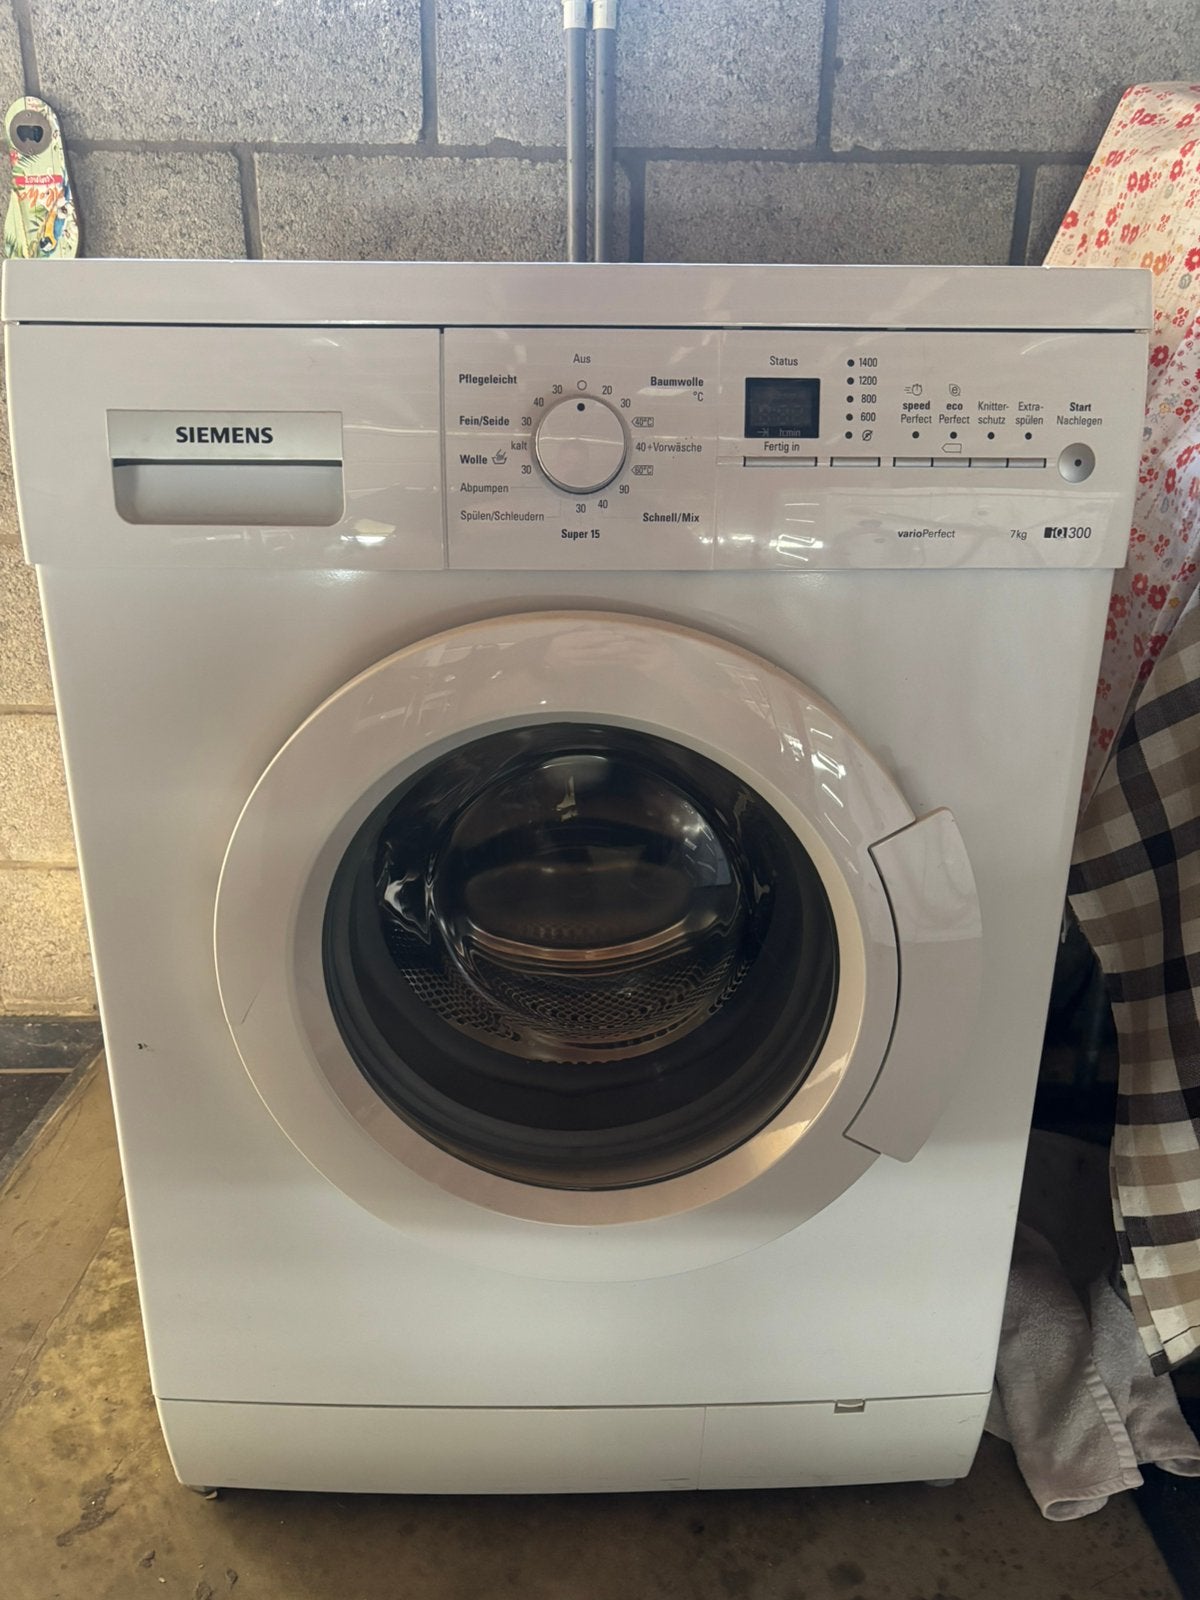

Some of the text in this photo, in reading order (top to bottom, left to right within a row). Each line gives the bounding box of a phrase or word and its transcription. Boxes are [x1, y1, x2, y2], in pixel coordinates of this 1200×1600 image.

[573, 354, 591, 363] Aus
[770, 356, 798, 366] Status
[859, 358, 877, 367] 1400
[459, 374, 517, 386] Pflegeleicht
[651, 376, 703, 386] Baumwolle
[859, 376, 877, 385] 1200
[552, 385, 562, 394] 30
[602, 385, 612, 395] 20
[693, 391, 703, 402] °C
[861, 394, 876, 403] 800
[534, 397, 544, 407] 40
[621, 398, 631, 408] 30
[902, 400, 931, 412] speed
[978, 401, 1009, 411] Knitter-
[1018, 401, 1044, 411] Extra-
[1070, 402, 1091, 411] Start
[460, 416, 509, 426] Fein/Seide
[522, 417, 532, 426] 30
[861, 412, 876, 421] 600
[901, 414, 932, 424] Perfect
[939, 414, 970, 424] Perfect
[978, 415, 1005, 424] schutz
[1016, 415, 1043, 426] spülen
[1057, 416, 1102, 427] Nachlegen
[176, 427, 273, 443] SIEMENS
[511, 441, 528, 450] kalt
[764, 441, 800, 453] Fertig in
[460, 455, 487, 464] Wolle
[522, 466, 531, 474] 30
[460, 483, 508, 494] Abpumpen
[619, 485, 629, 494] 90
[576, 504, 586, 513] 30
[598, 499, 608, 508] 40
[461, 510, 544, 521] Spülen/Schleudern
[643, 513, 699, 523] Schnell/Mix
[562, 529, 600, 540] Super 15
[898, 529, 955, 538] varioPerfect
